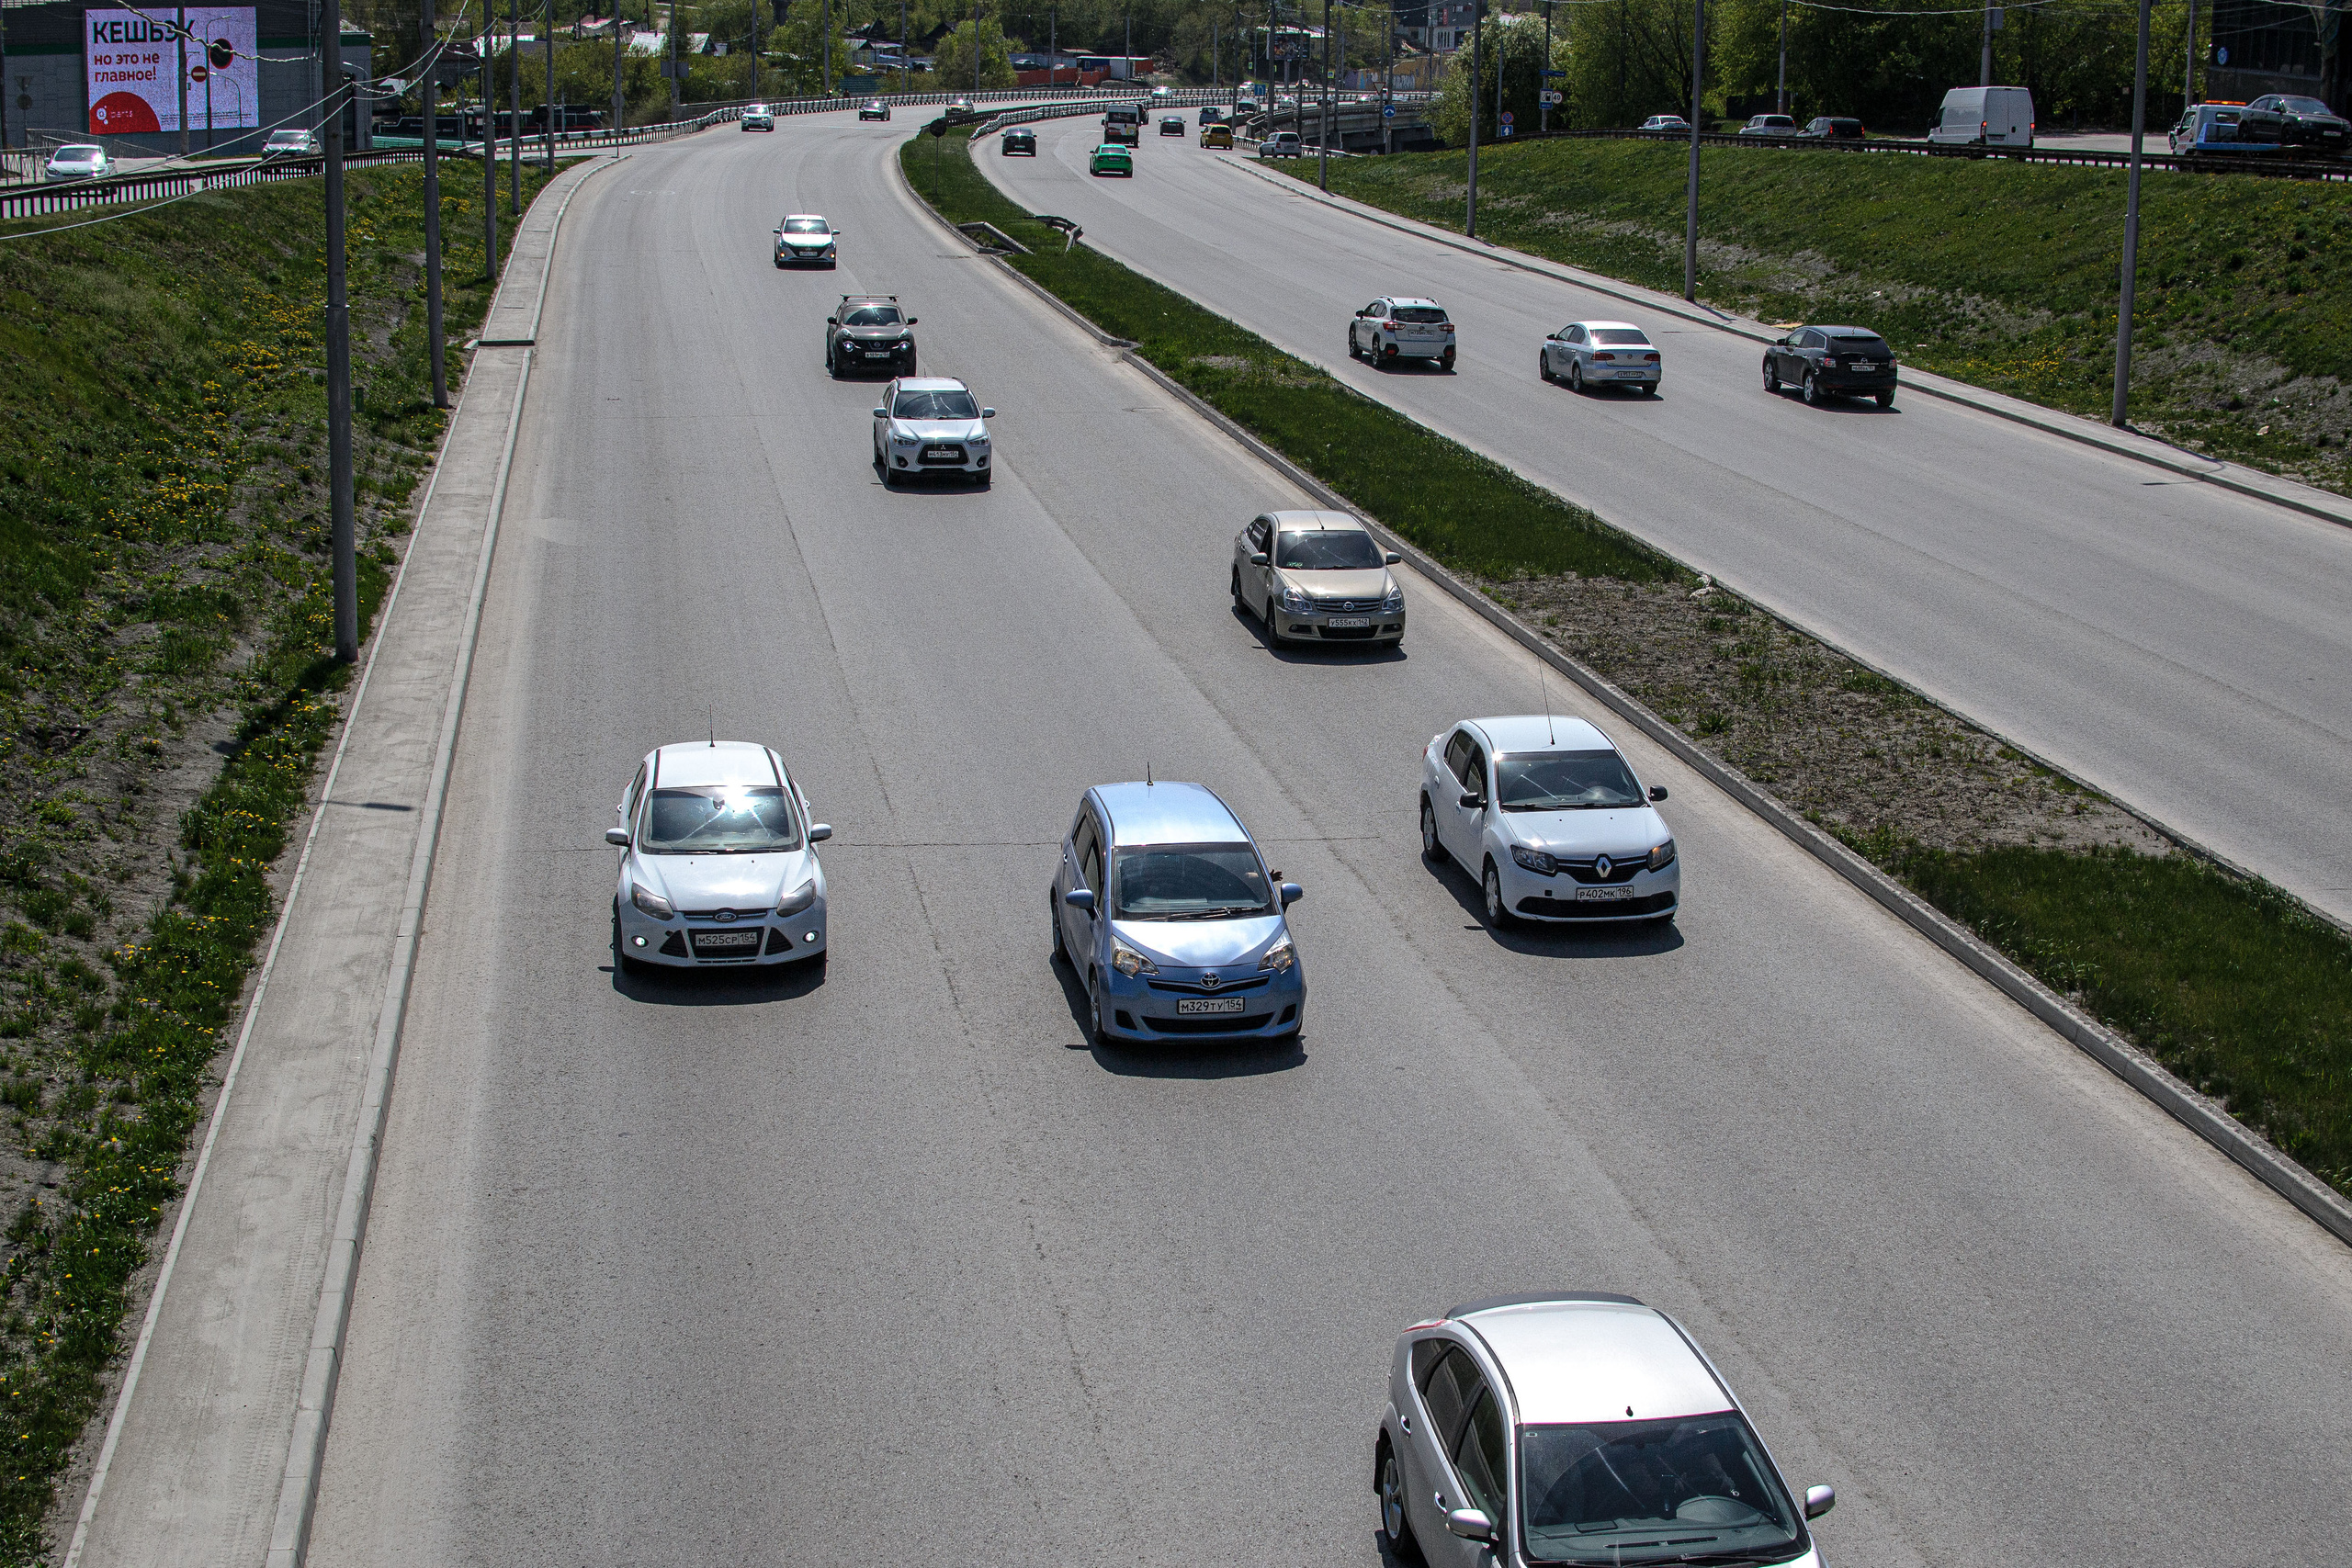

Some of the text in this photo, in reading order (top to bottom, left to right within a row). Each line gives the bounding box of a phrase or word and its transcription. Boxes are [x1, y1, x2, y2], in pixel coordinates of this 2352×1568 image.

[94, 52, 160, 65] но это не
[95, 66, 157, 83] главное!
